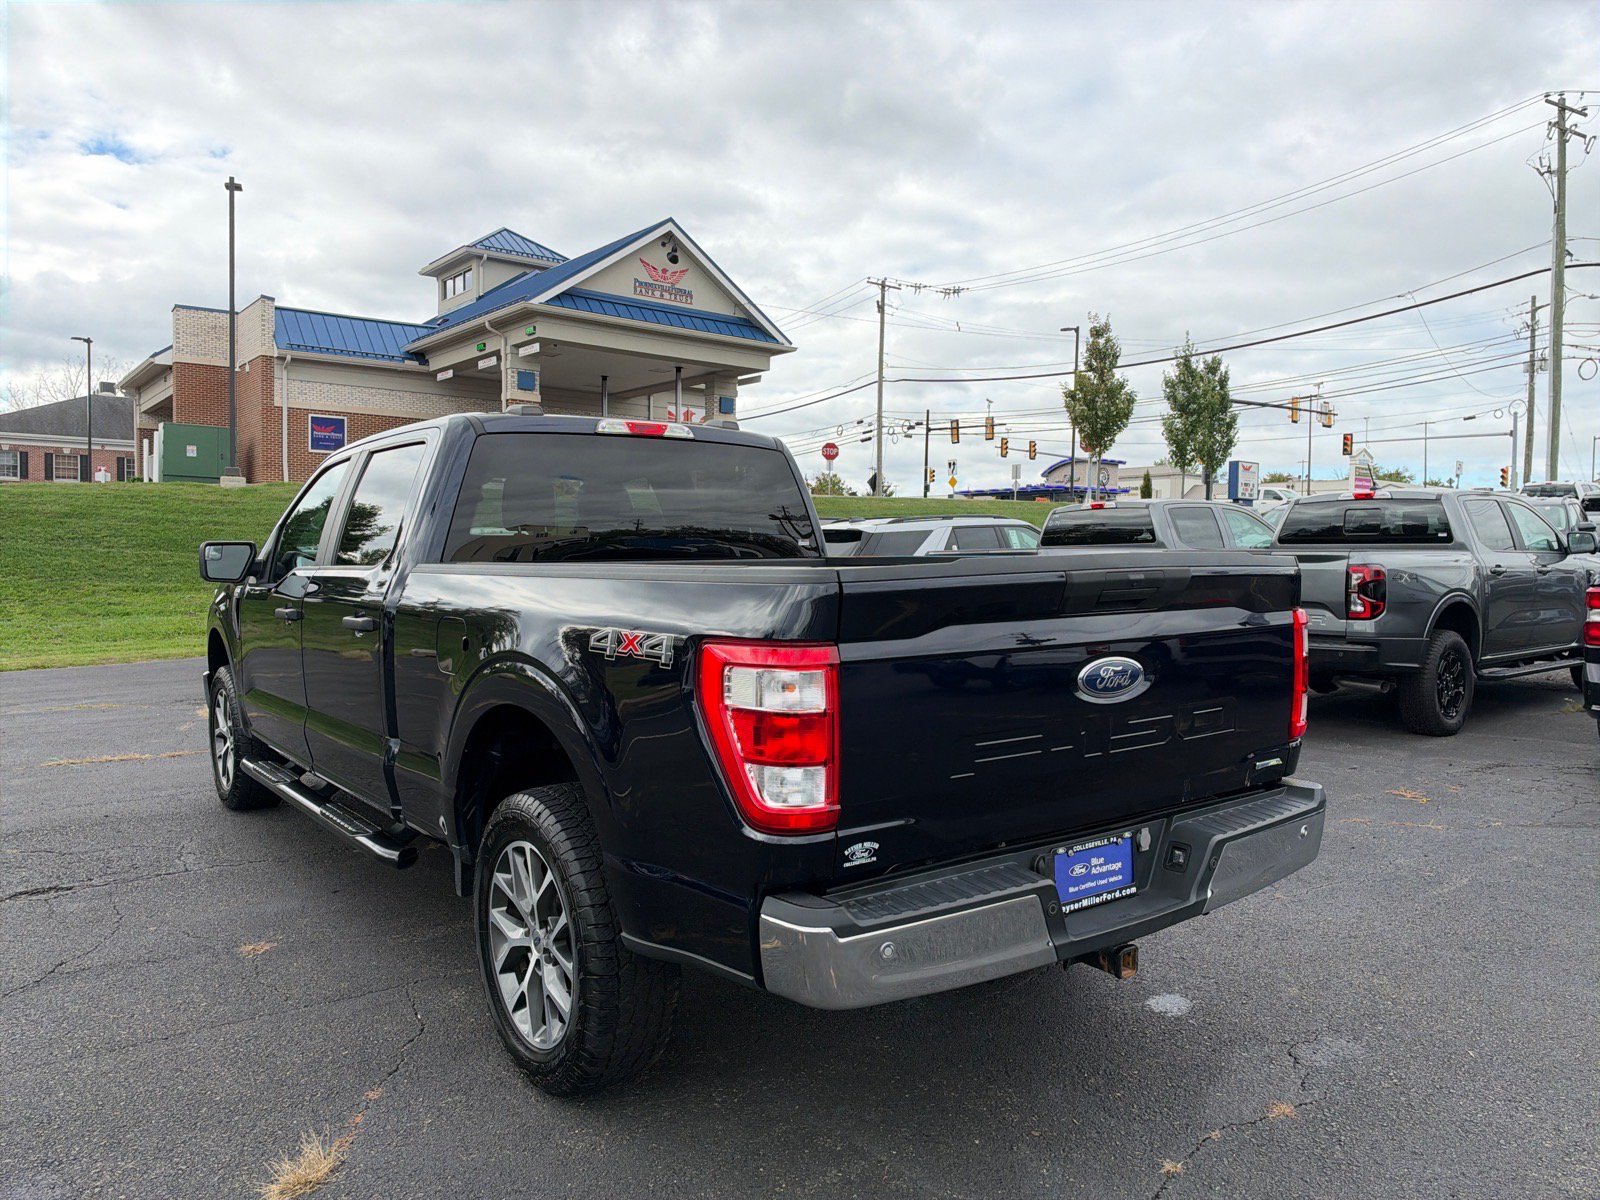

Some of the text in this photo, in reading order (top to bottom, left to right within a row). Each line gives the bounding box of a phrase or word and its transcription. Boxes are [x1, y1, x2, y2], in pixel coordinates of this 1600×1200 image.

[634, 287, 655, 296] BANK
[669, 293, 693, 303] TRUST
[822, 447, 839, 456] STOP
[1096, 665, 1132, 689] Ford
[1073, 839, 1109, 852] COLLEGEVILLE,
[1090, 857, 1105, 866] Blue
[1091, 861, 1122, 874] Advantage
[1079, 880, 1097, 890] Certified
[1096, 877, 1108, 887] Used
[1061, 886, 1137, 914] eyserMillerFord.com
